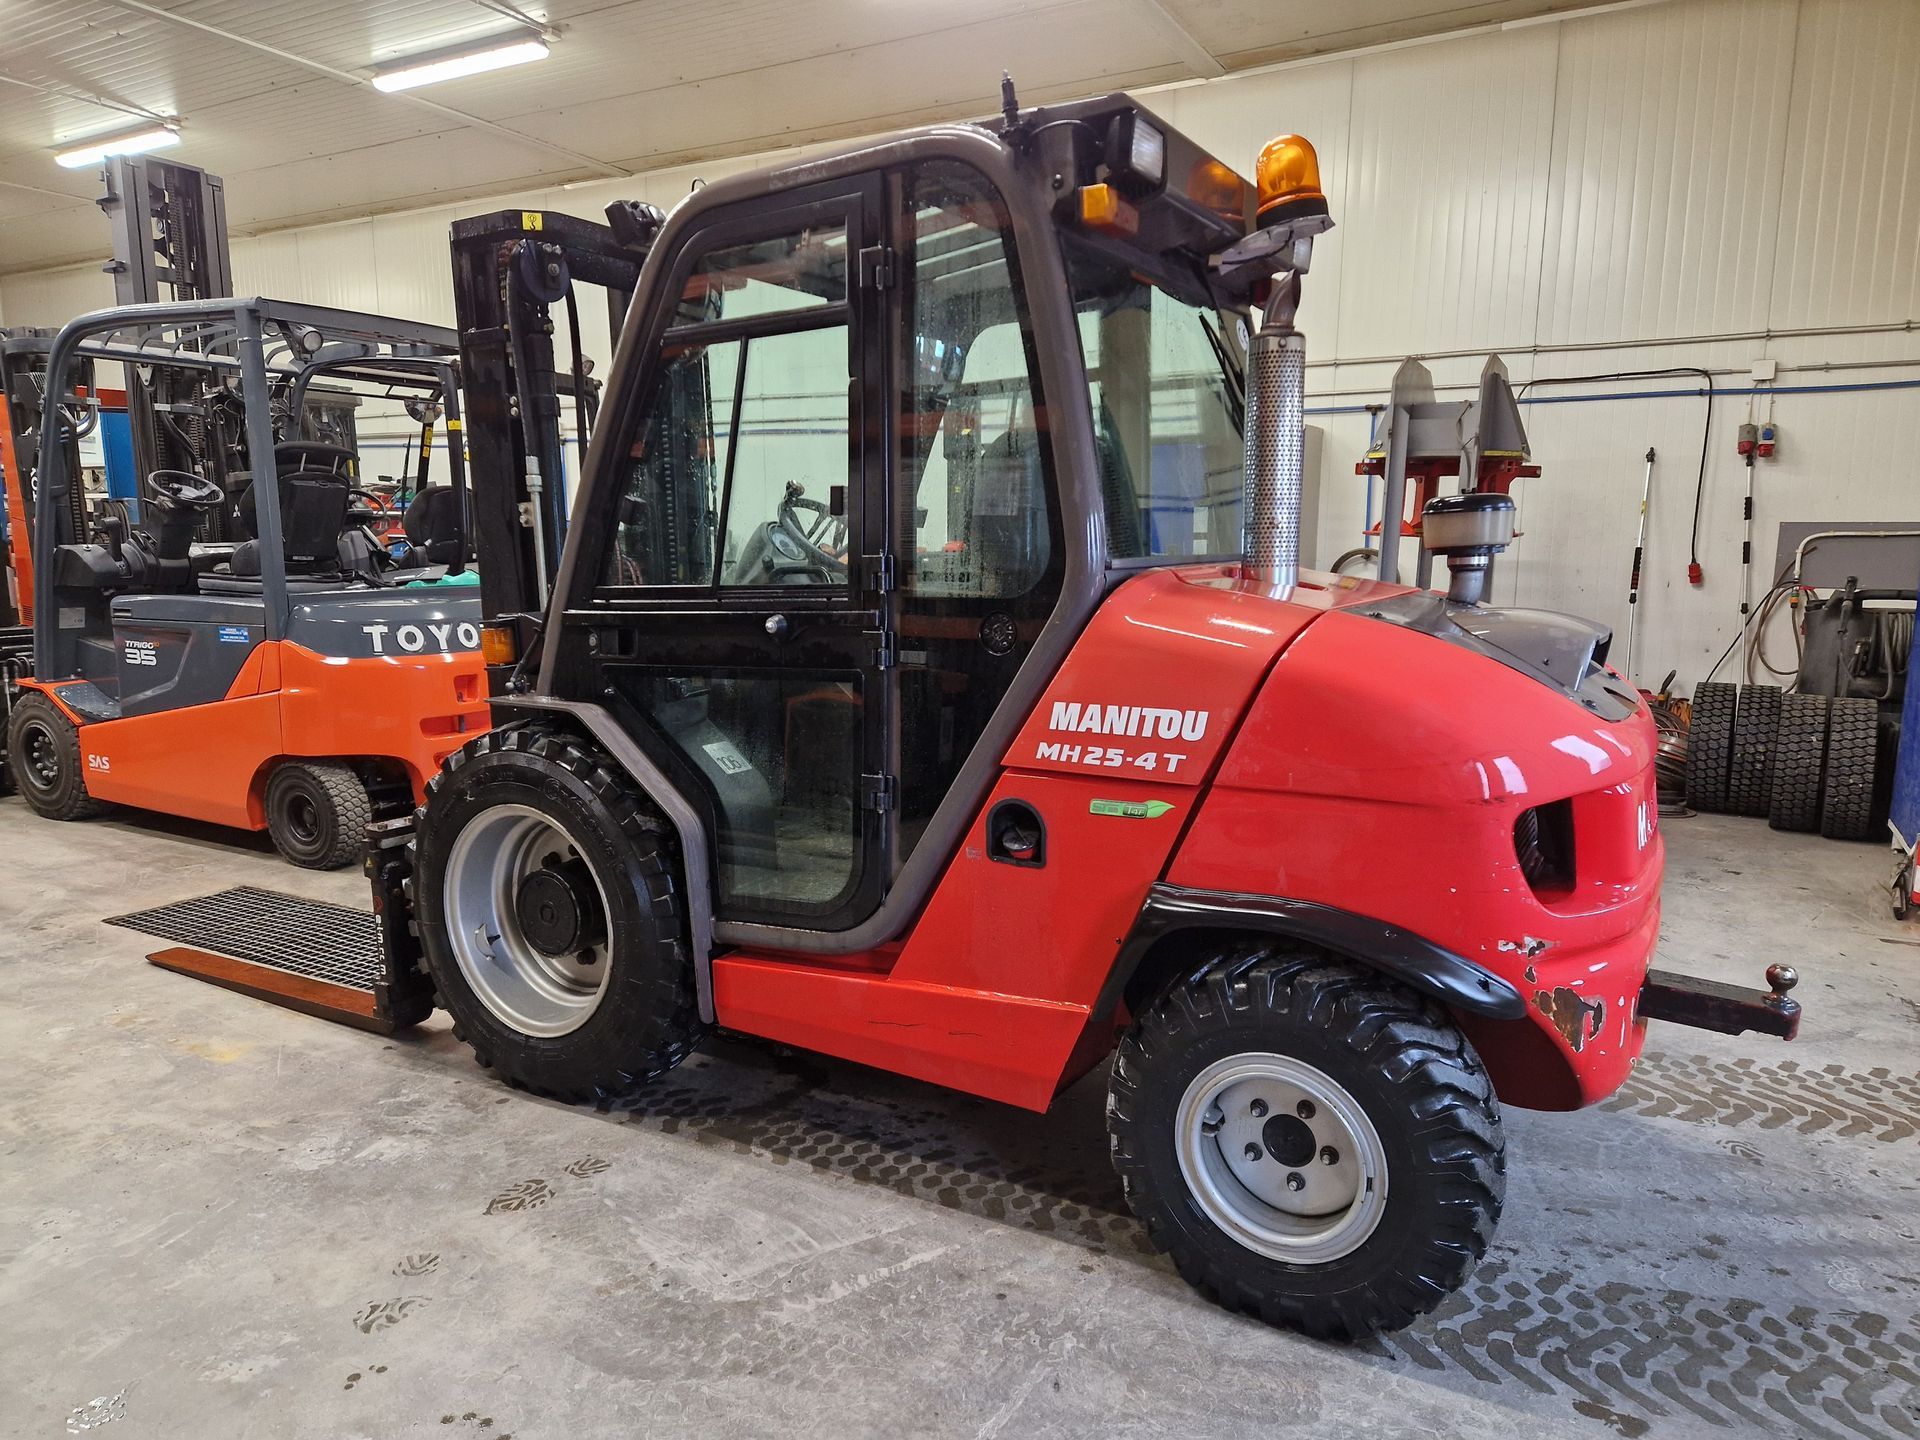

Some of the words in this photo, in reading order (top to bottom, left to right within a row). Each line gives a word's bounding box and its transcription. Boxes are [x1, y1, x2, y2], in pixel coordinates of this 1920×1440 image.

[361, 622, 485, 653] TOYO
[124, 648, 158, 666] 35
[1049, 701, 1209, 742] MANITOU
[88, 754, 110, 770] SAS
[716, 754, 743, 770] 106
